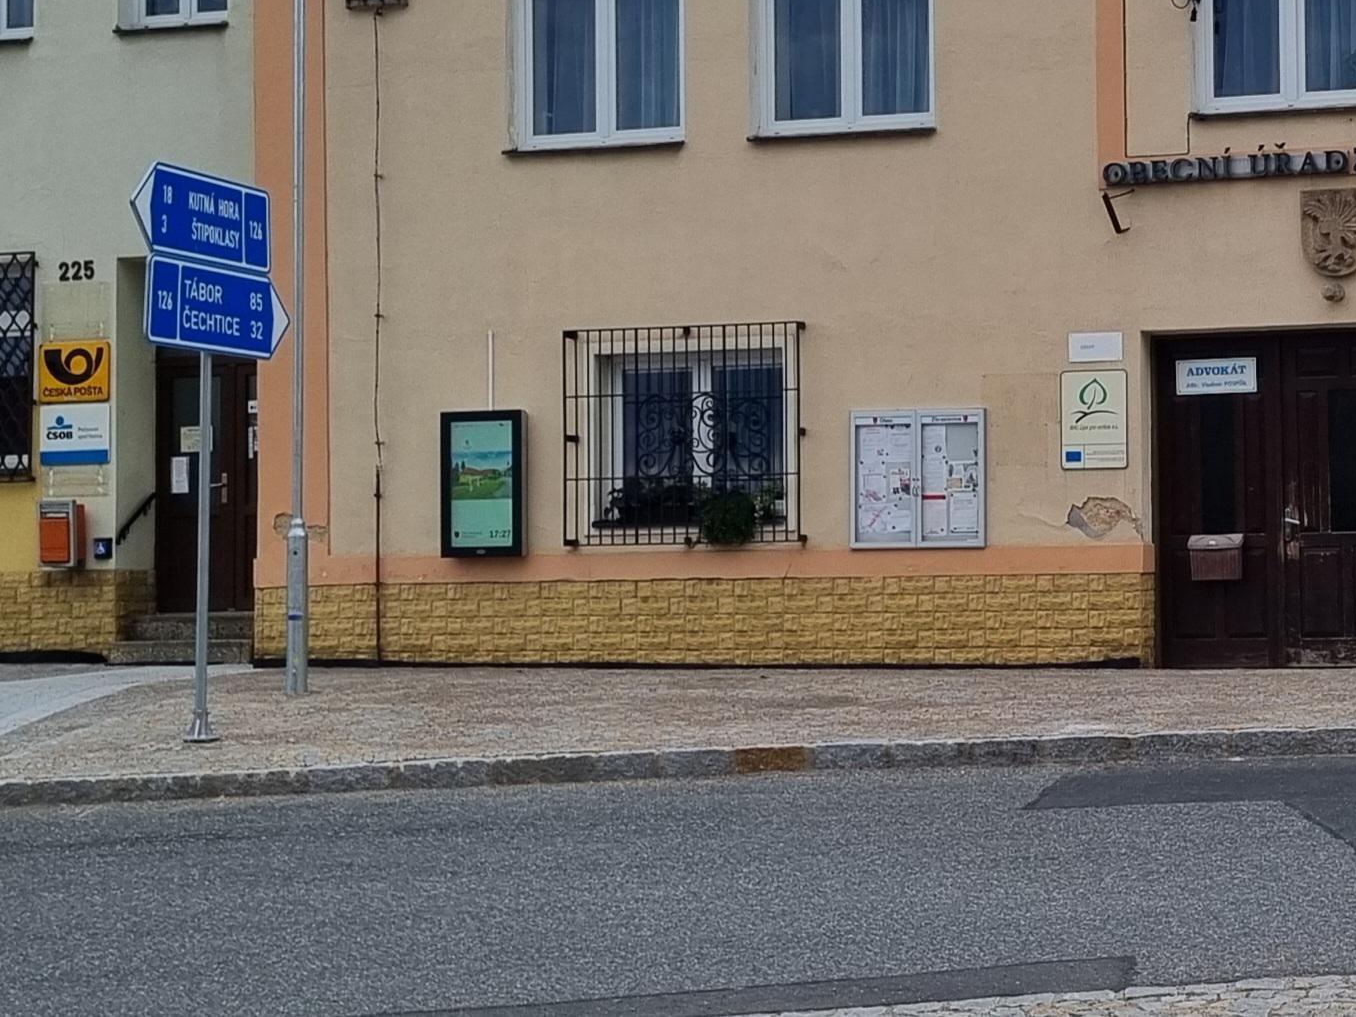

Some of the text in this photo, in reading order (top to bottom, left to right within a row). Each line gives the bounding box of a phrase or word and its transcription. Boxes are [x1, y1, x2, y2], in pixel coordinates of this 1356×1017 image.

[1102, 146, 1231, 185] OBECNÍ
[1247, 142, 1350, 177] ÚŘAD
[163, 185, 240, 221] 18 KUTNÁ HORA
[161, 215, 240, 249] 3 ŠTIPOKLASY
[249, 220, 263, 240] 126
[58, 260, 95, 282] 225
[157, 276, 263, 312] 126 TÁBOR 85
[183, 305, 263, 339] ČECHTICE 32
[1186, 363, 1247, 377] ADVOKÁT
[43, 385, 103, 397] ČESKÁ POŠTA
[46, 429, 73, 440] ČSOB
